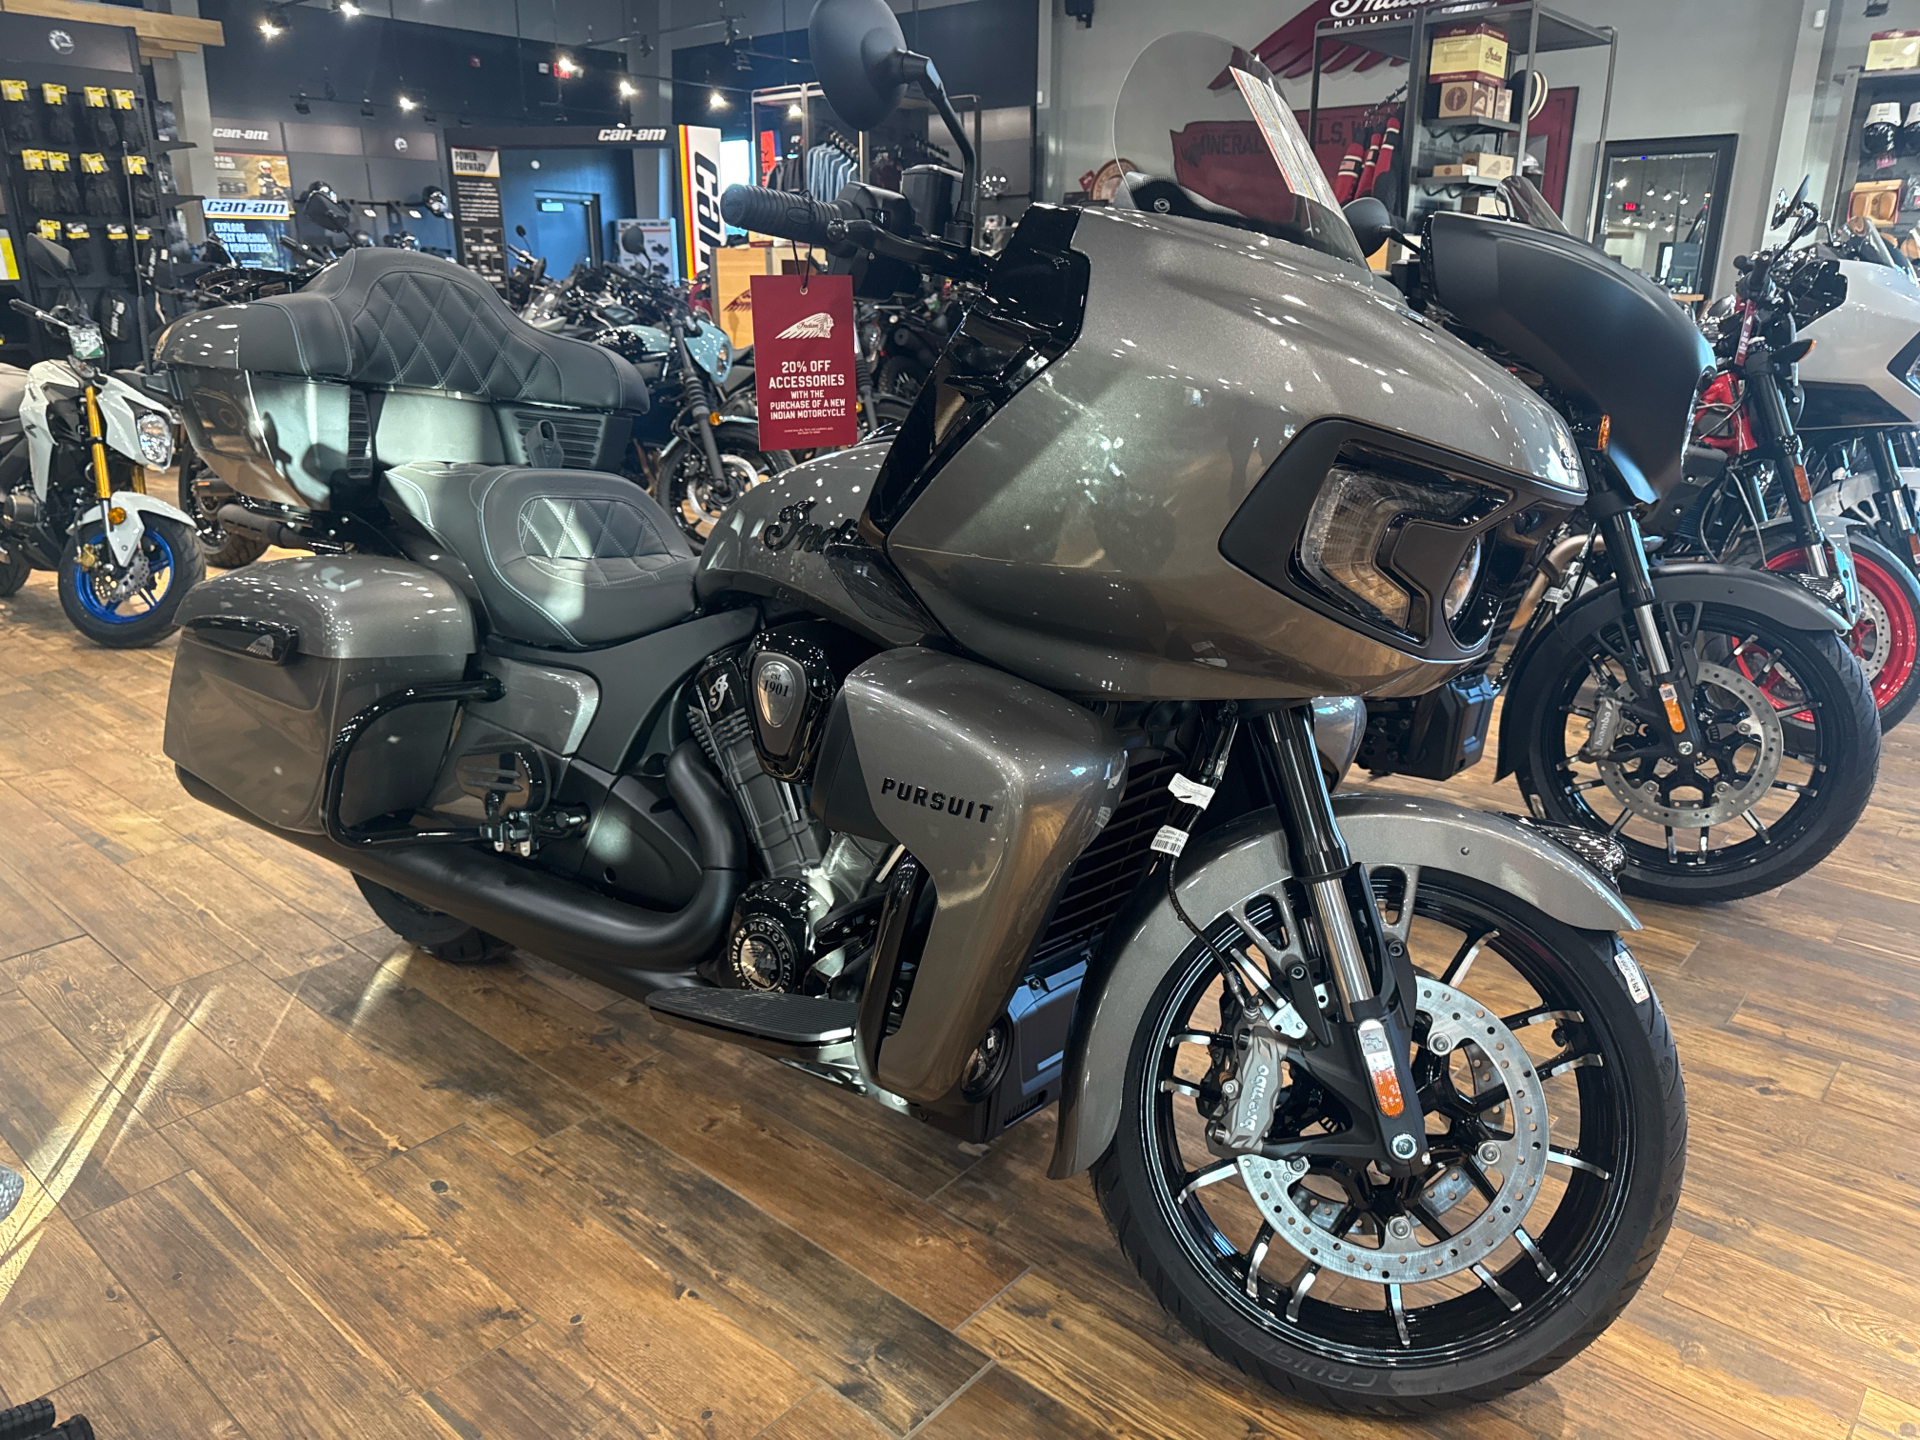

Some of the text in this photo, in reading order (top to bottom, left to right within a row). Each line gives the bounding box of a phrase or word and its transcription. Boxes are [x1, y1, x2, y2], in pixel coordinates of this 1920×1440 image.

[213, 128, 269, 141] can-am
[598, 129, 667, 141] can-am
[207, 201, 286, 214] can-am
[213, 222, 246, 233] EXPLORE
[781, 360, 831, 373] 20% OFF
[768, 373, 845, 389] ACCESSORIES
[790, 389, 825, 399] WITH THE
[770, 398, 846, 410] PURCHASE OF A NEW
[770, 408, 846, 420] INDIAN MOTORCYCLE
[764, 680, 789, 697] 1901
[1595, 711, 1611, 746] brembo
[881, 777, 994, 824] PURSUIT
[731, 923, 790, 994] INDIAN MOTORCYCLE
[1239, 1064, 1270, 1131] brembo
